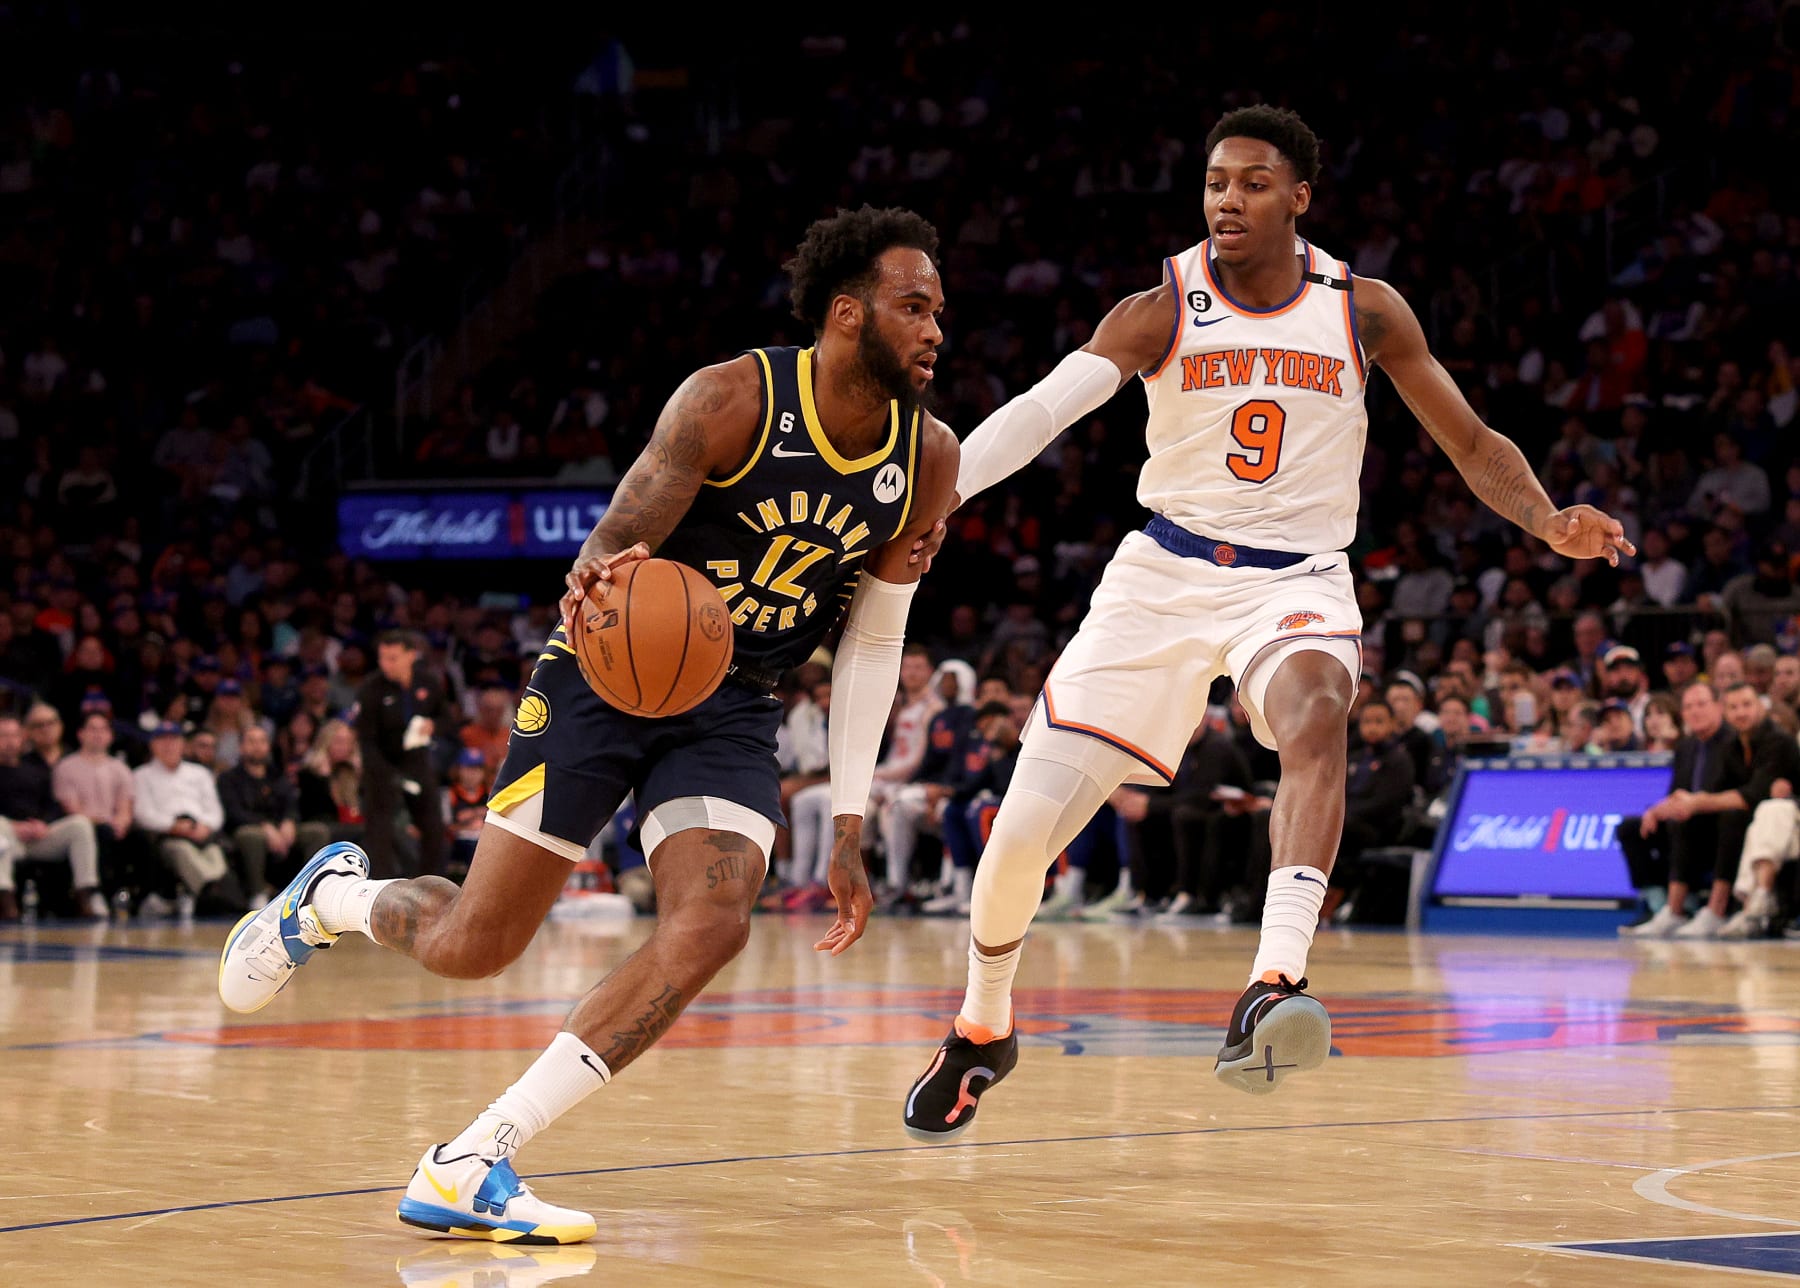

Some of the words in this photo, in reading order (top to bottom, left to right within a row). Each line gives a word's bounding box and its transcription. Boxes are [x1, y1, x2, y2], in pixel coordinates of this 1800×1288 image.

[1192, 293, 1207, 311] 6
[1181, 348, 1257, 393] NEW
[1260, 347, 1345, 398] YORK
[779, 411, 796, 434] 6
[1226, 399, 1287, 484] 9
[750, 534, 835, 600] 12
[706, 559, 817, 633] PACERS
[1563, 814, 1622, 850] ULT
